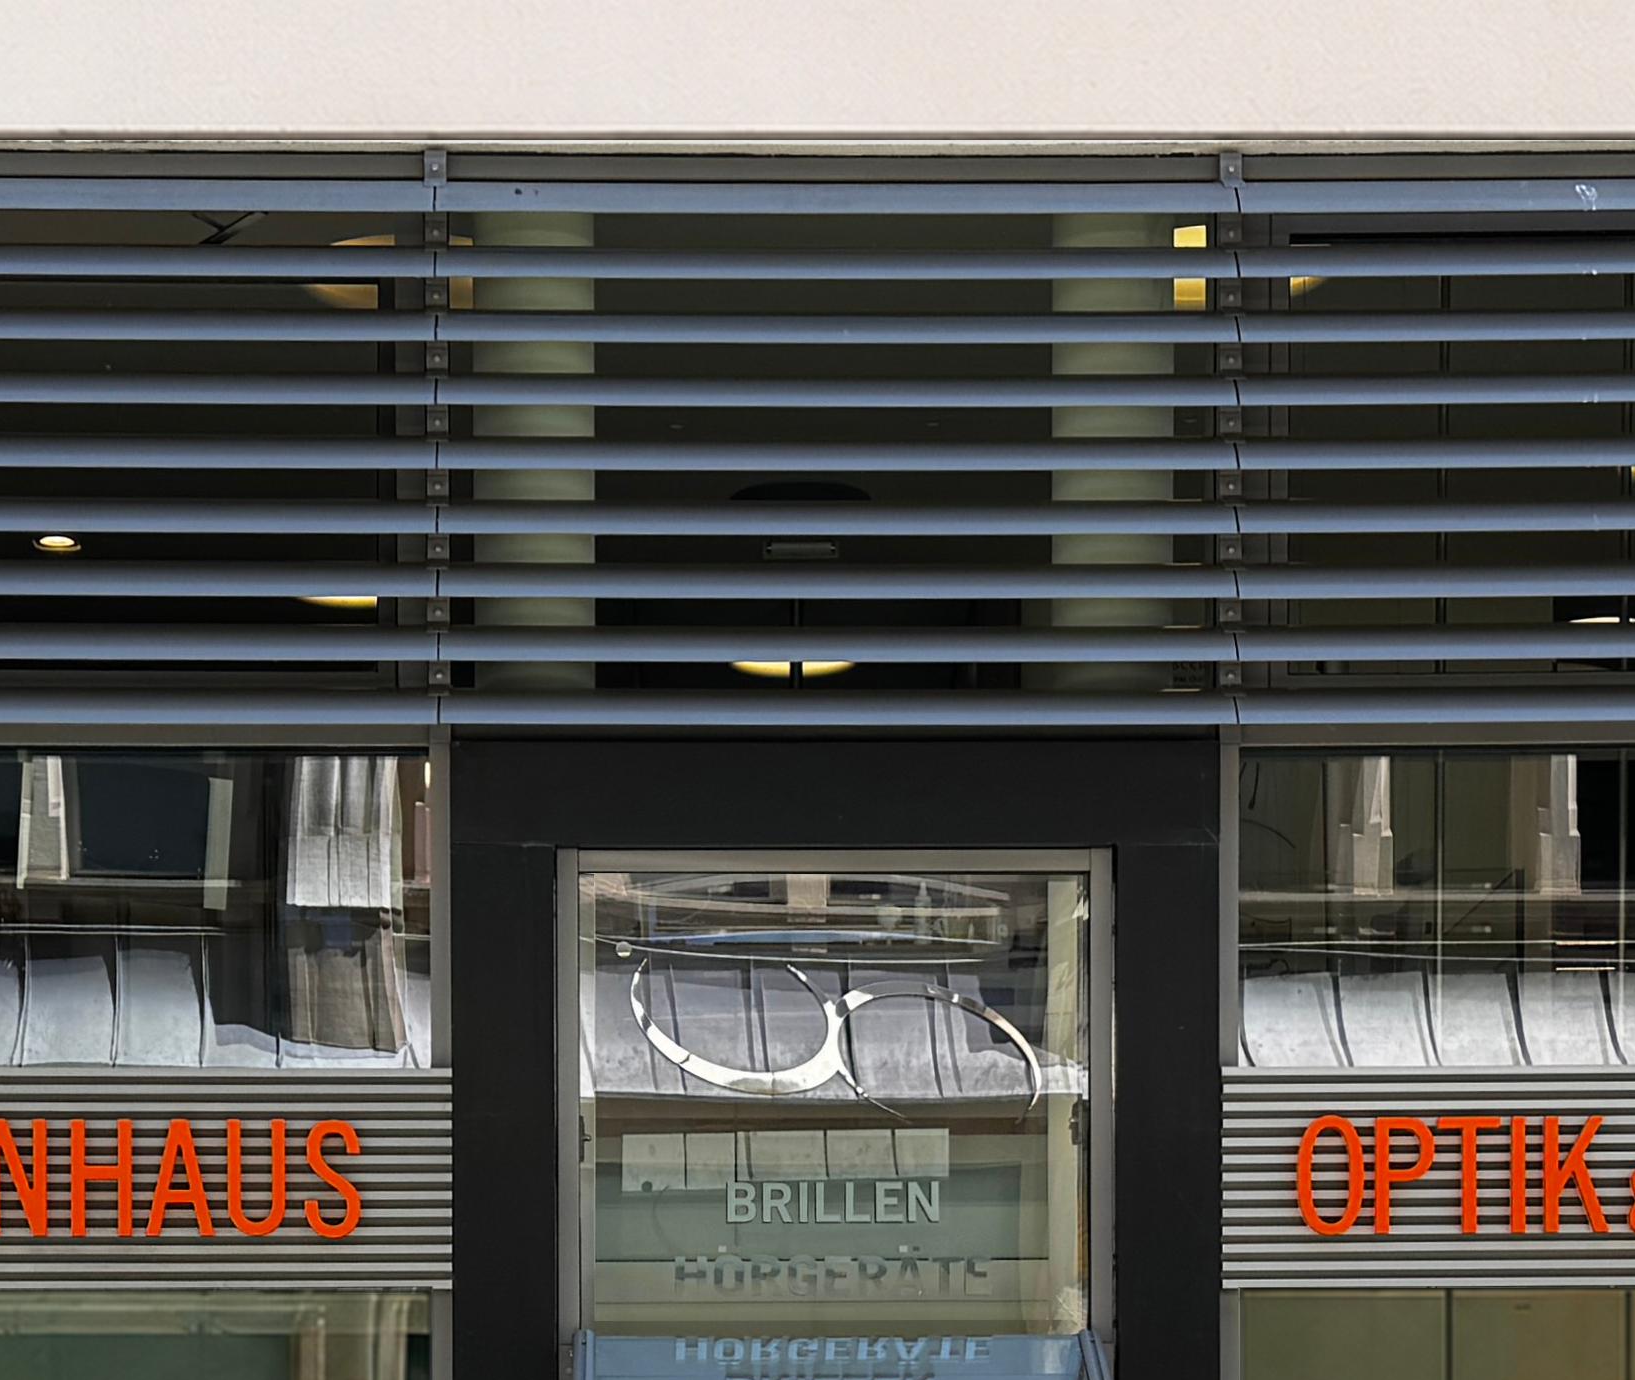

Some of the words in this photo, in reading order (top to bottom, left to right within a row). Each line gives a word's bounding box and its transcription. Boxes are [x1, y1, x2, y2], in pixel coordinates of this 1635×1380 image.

[1296, 1115, 1610, 1236] OPTIK
[726, 1181, 940, 1223] BRILLEN
[674, 1245, 993, 1297] HÖRGERÄTE
